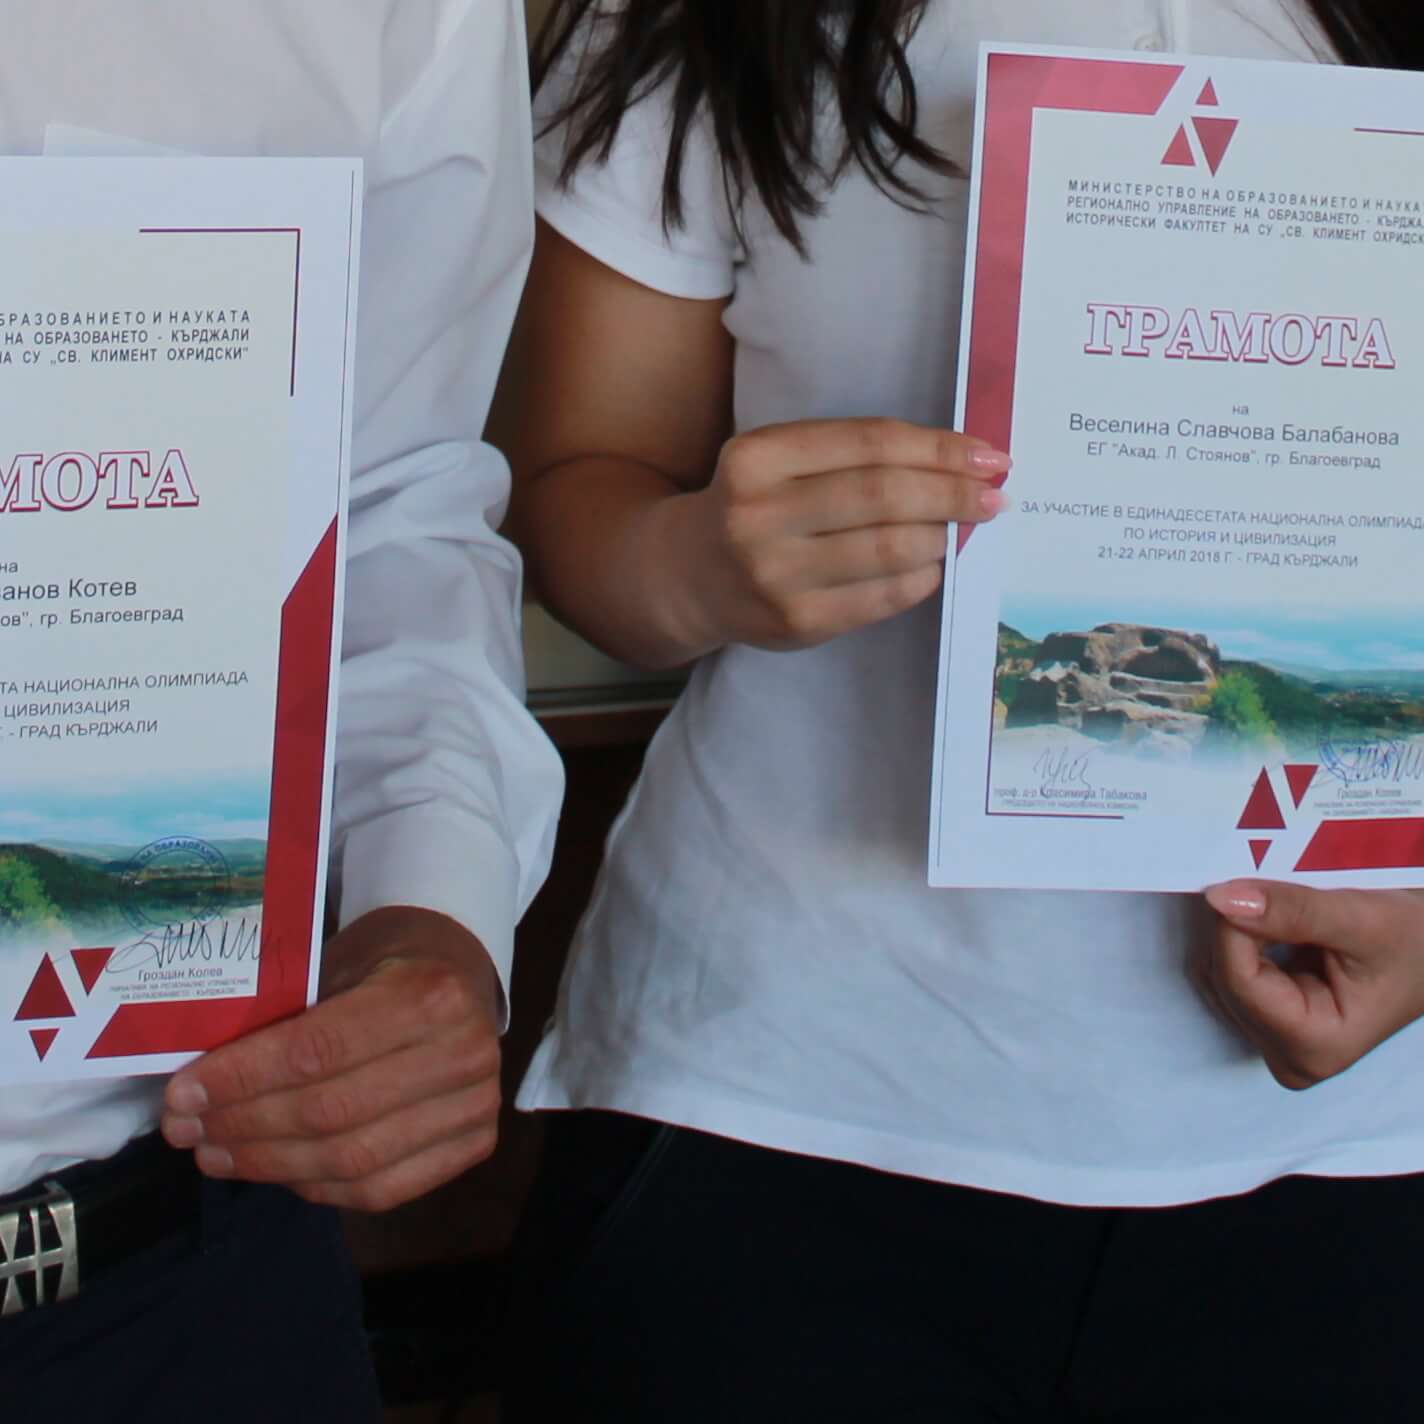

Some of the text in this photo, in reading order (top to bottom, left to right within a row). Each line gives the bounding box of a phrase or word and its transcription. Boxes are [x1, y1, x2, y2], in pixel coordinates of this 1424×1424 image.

[1068, 178, 1197, 200] МИНИСТЕРСТВО
[1201, 188, 1220, 201] НА
[1225, 189, 1358, 209] ОБРАЗОВАНИЕТО
[1362, 198, 1370, 209] И
[1066, 195, 1151, 213] РЕГИОНАЛНО
[1157, 201, 1237, 219] УПРАВЛЕНИЕ
[1244, 207, 1260, 219] НА
[1267, 208, 1360, 226] ОБРАЗОВАНЕТО
[1065, 211, 1157, 229] ИСТОРИЧЕСКИ
[1163, 218, 1227, 233] ФАКУЛТЕТ
[1233, 222, 1250, 234] НА
[1257, 223, 1273, 237] СУ
[1312, 227, 1367, 241] КЛИМЕНТ
[153, 311, 162, 325] И
[168, 309, 250, 324] НАУКАТА
[4, 331, 24, 345] НА
[33, 329, 149, 345] ОБРАЗОВАНЕТО
[171, 327, 250, 345] КЪРДЖАЛИ
[1084, 302, 1396, 369] ГРАМОТА
[22, 350, 41, 365] СУ
[90, 347, 158, 363] КЛИМЕНТ
[1069, 413, 1400, 446] Веселина Славчова Балабанова
[1087, 441, 1108, 456] ЕГ
[1288, 450, 1381, 470] Благоевград
[1020, 500, 1040, 513] ЗА
[1043, 502, 1109, 518] УЧАСТИЕ
[1113, 505, 1122, 517] В
[1127, 505, 1247, 523] ЕДИНАДЕСЕТАТА
[1249, 511, 1345, 528] НАЦИОНАЛНА
[1123, 527, 1337, 549] ПО ИСТОРИЯ И ЦИВИЛИЗАЦИЯ
[1097, 546, 1135, 560] 21-22
[1137, 547, 1187, 562] АПРИЛ
[1189, 549, 1221, 564] 2018
[1245, 551, 1281, 567] ГРАД
[1283, 553, 1359, 569] КЪРДЖАЛИ
[68, 578, 137, 599] Котев
[69, 608, 184, 625] Благоевград
[23, 675, 140, 696] НАЦИОНАЛНА
[144, 671, 249, 689] ОЛИМПИАДА
[3, 698, 130, 721] ЦИВИЛИЗАЦИЯ
[19, 723, 62, 740] ГРАД
[65, 719, 158, 737] КЪРДЖАЛИ
